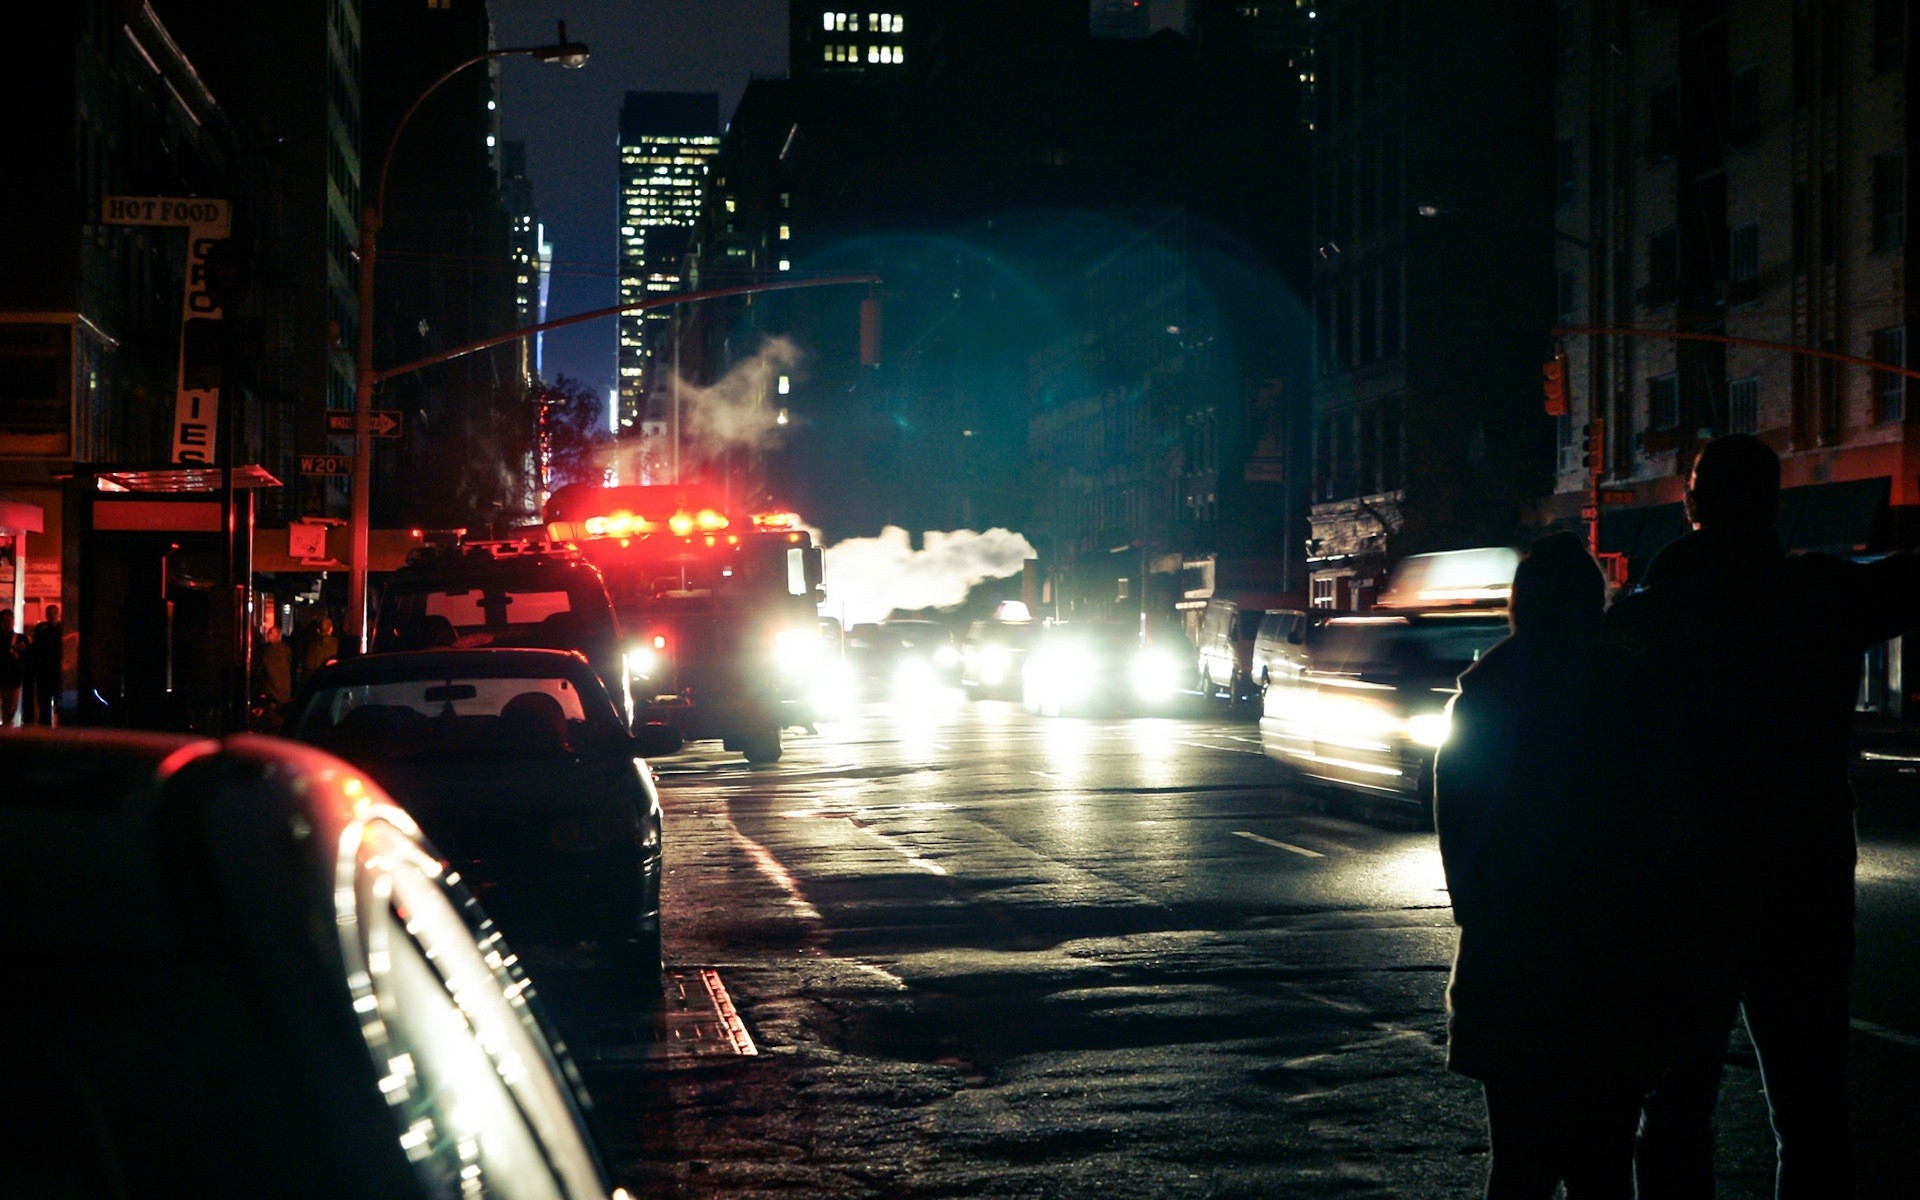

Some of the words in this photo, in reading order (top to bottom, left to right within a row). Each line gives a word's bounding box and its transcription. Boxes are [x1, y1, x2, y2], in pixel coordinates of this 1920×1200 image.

[109, 200, 156, 220] HOT
[161, 201, 219, 222] FOOD
[336, 418, 357, 430] ON
